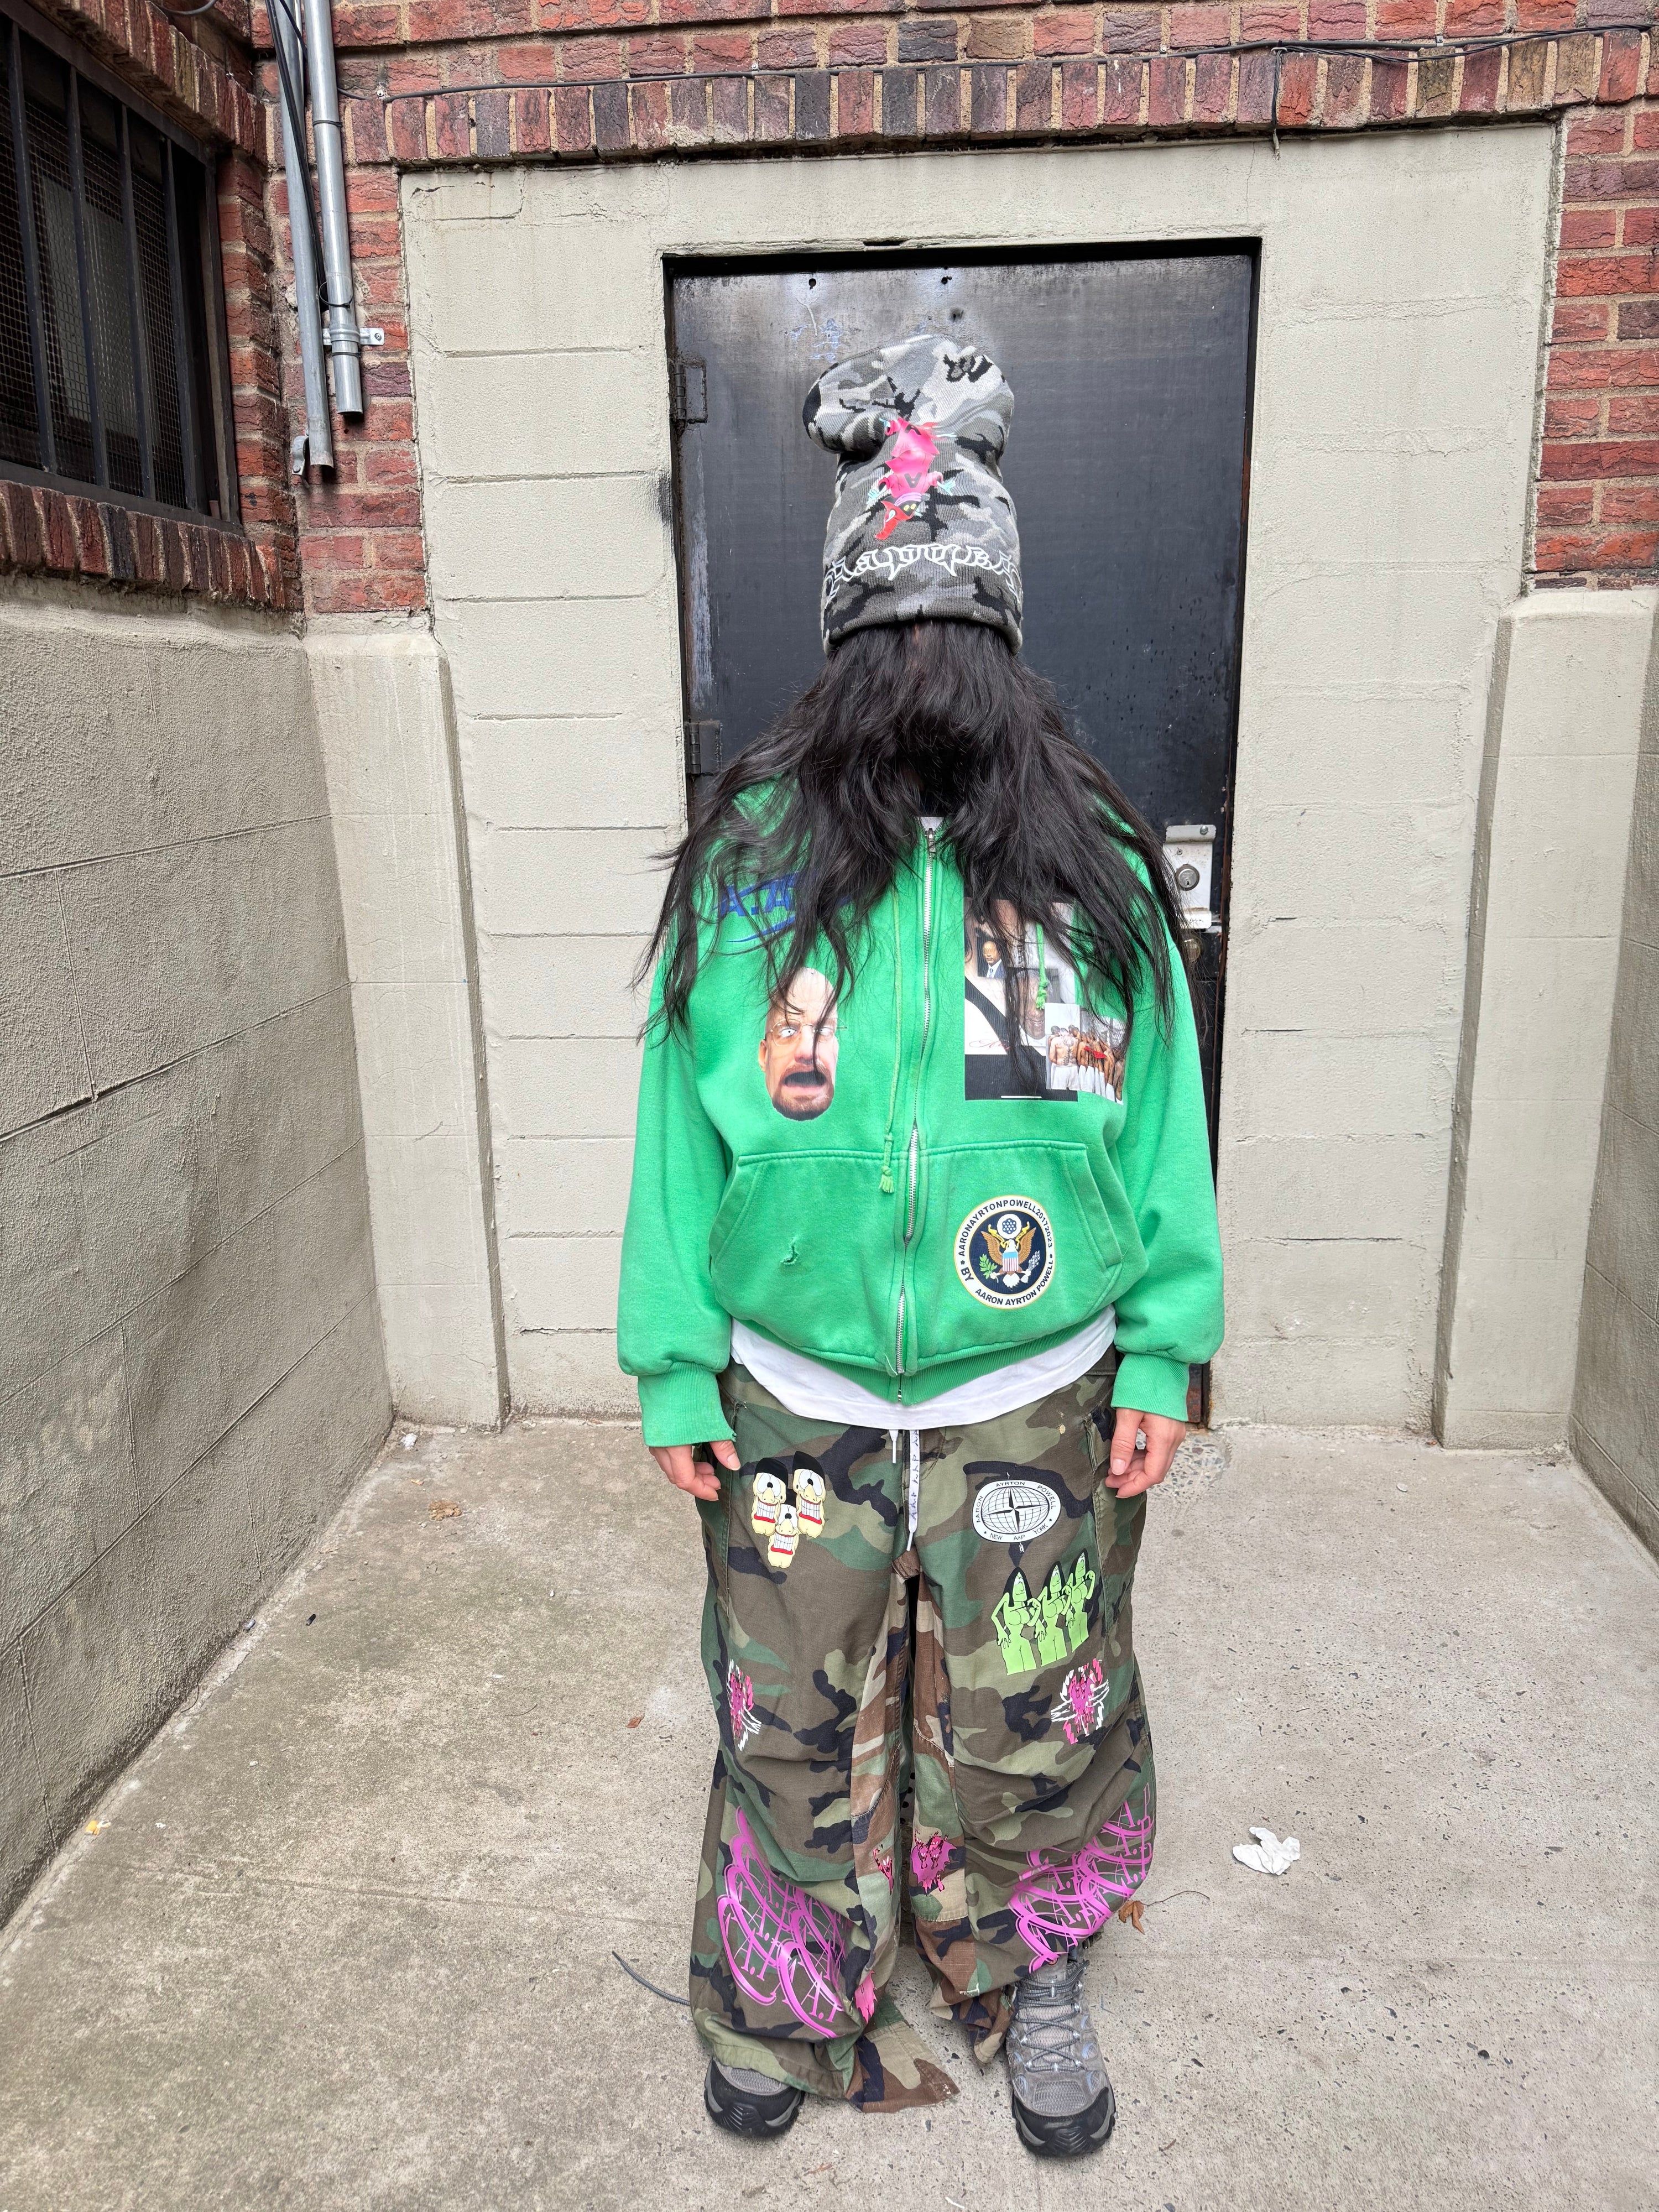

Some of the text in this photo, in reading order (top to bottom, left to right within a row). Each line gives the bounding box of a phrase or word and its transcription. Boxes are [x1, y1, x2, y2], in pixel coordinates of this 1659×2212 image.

[961, 1260, 1053, 1306] BY AARON AYRTON POWELL
[975, 1495, 984, 1523] AARON
[1037, 1485, 1057, 1510] POWELL
[989, 1532, 1003, 1541] NEW
[1032, 1523, 1048, 1535] YORK
